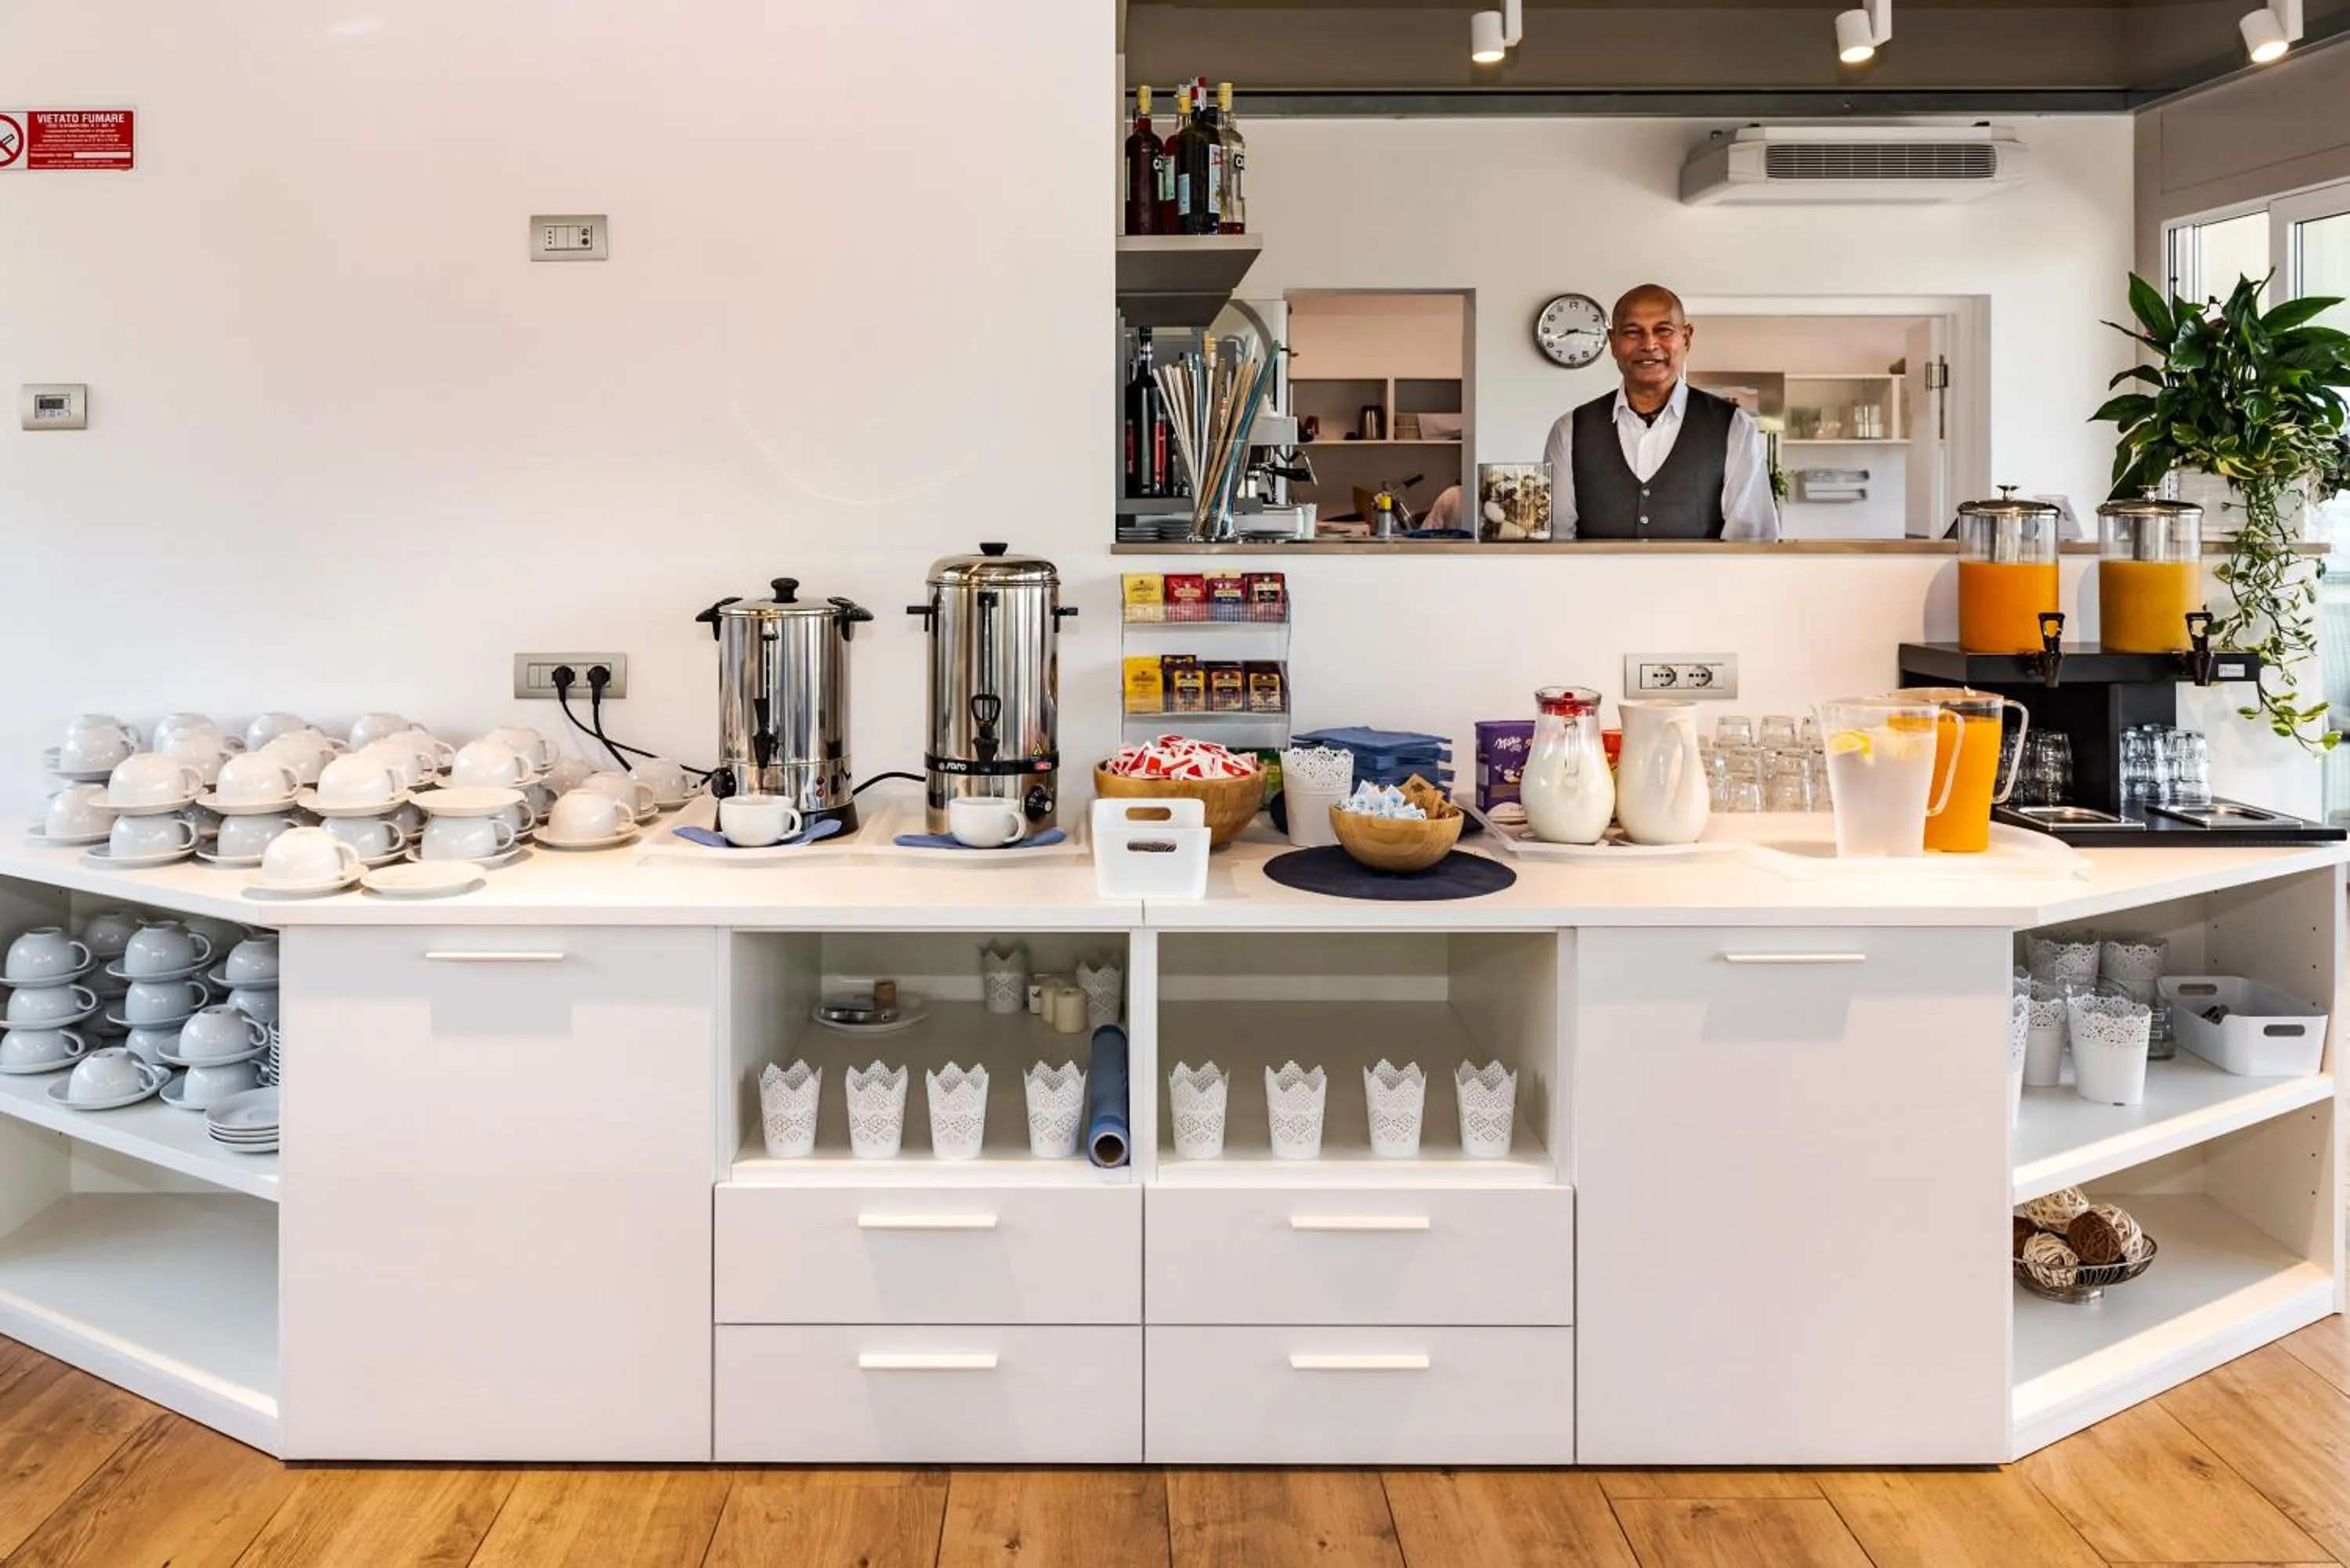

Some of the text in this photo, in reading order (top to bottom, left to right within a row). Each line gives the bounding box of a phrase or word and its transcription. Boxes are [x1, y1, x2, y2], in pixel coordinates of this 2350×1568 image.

[37, 114, 125, 123] VIETATO FUMARE
[1569, 353, 1577, 362] 6
